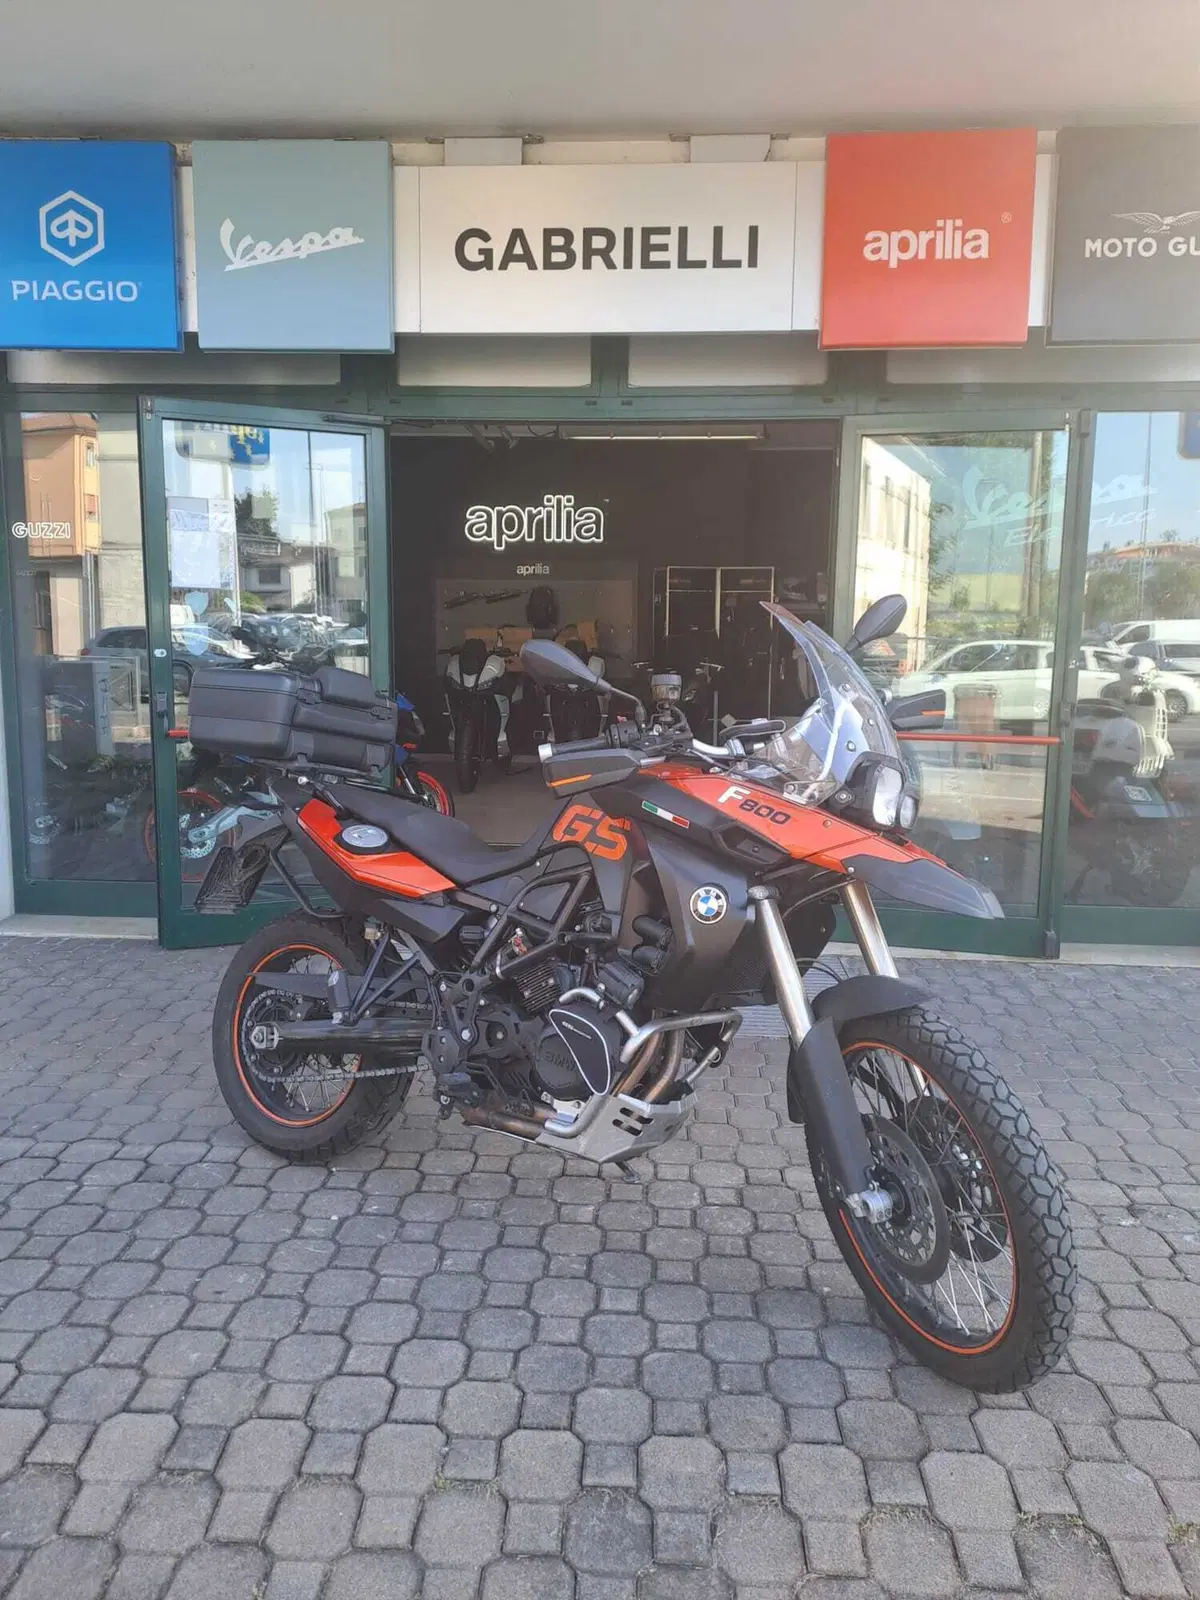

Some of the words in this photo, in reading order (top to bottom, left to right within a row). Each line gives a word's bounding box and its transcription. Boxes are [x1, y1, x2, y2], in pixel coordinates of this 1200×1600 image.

[219, 217, 365, 272] Vespa
[454, 225, 759, 271] GABRIELLI
[862, 218, 990, 269] aprilia
[1084, 236, 1158, 258] MOTO
[11, 279, 138, 302] PIAGGIO
[11, 521, 72, 539] GUZZI
[464, 494, 605, 551] aprilia
[516, 563, 550, 576] aprilia
[738, 799, 792, 825] 800
[552, 804, 632, 861] GS
